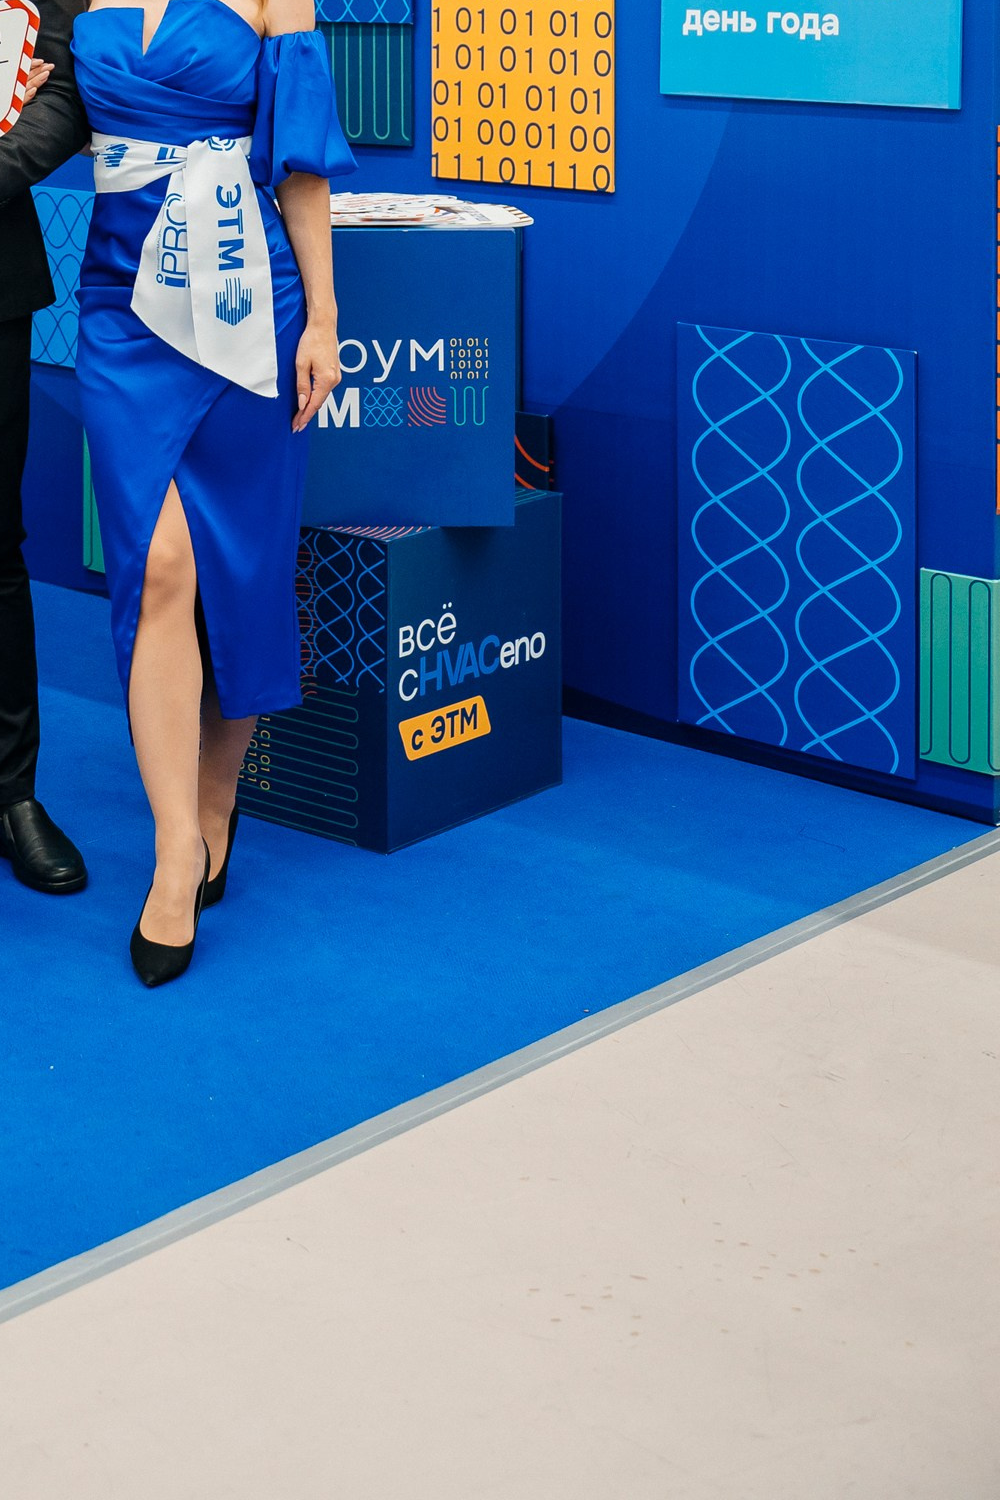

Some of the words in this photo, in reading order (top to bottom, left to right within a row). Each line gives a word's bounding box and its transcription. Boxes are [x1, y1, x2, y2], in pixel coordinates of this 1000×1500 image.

[682, 9, 757, 37] день
[767, 11, 840, 41] года
[215, 183, 245, 271] ЭТМ
[430, 702, 478, 744] ЭТМ
